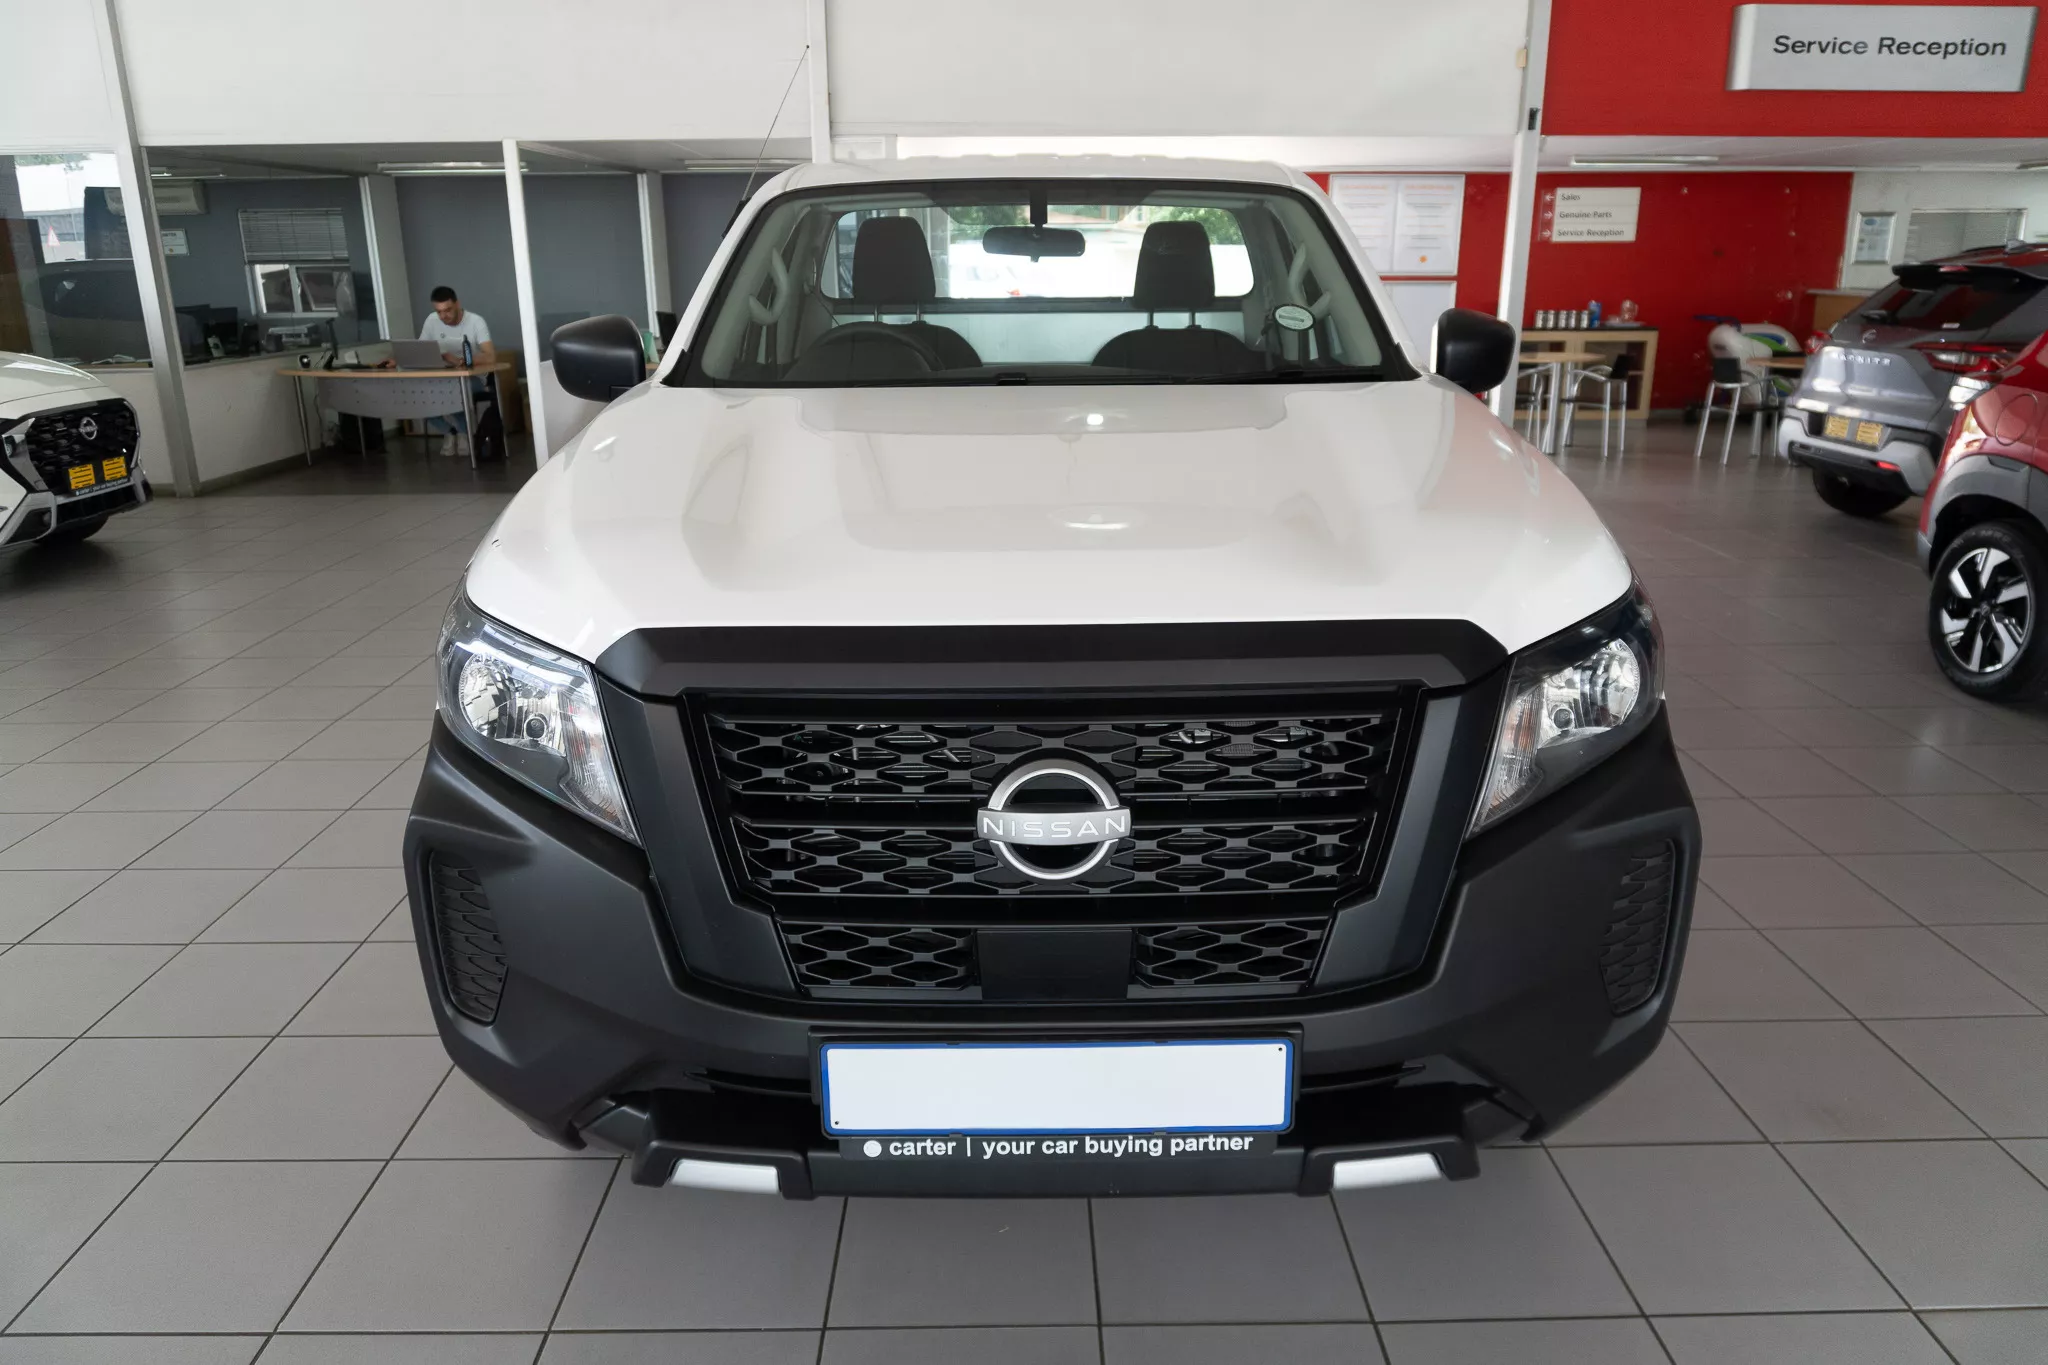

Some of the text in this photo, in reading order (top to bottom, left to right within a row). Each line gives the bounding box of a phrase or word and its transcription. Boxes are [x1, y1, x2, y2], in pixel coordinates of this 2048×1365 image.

[1773, 35, 2007, 59] Service Reception
[1561, 193, 1581, 201] Sales
[1559, 211, 1612, 219] Genuine Parts
[1558, 229, 1625, 238] Service Reception
[983, 815, 1126, 838] NISSAN
[888, 1139, 957, 1157] carter
[982, 1140, 1035, 1160] your
[1041, 1139, 1079, 1156] car
[1085, 1135, 1163, 1157] buying
[1170, 1135, 1254, 1156] partner
